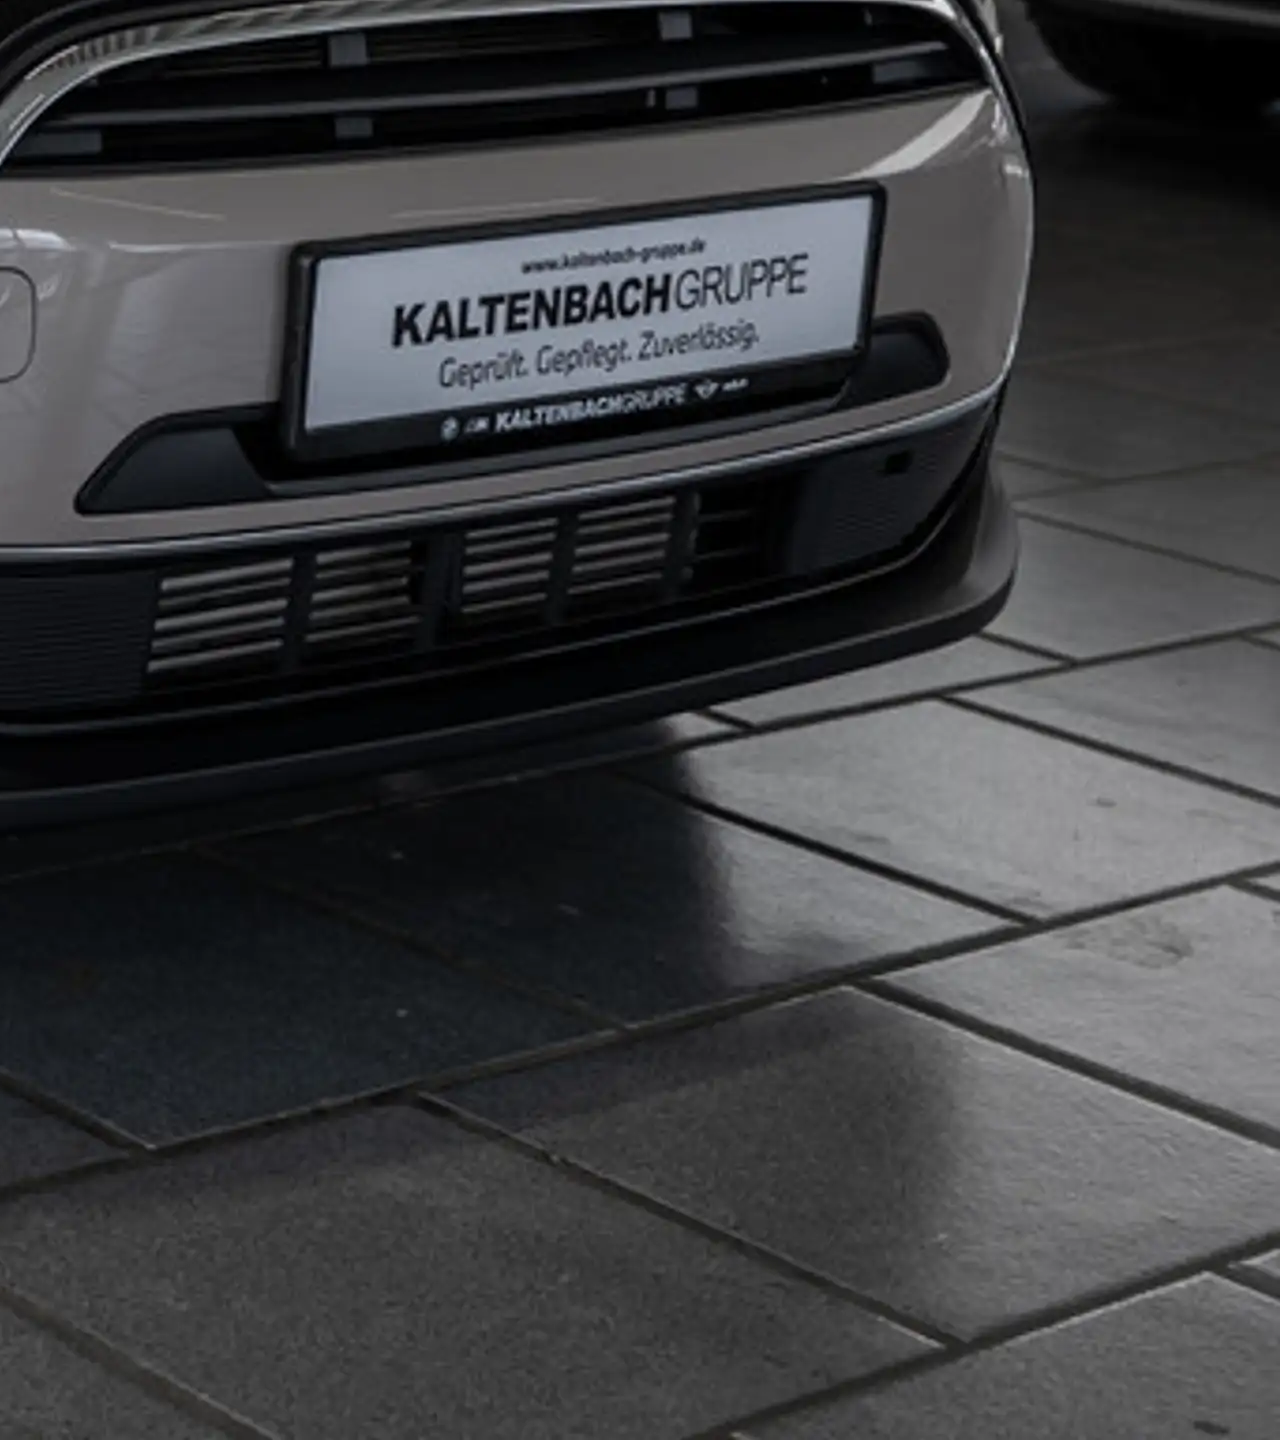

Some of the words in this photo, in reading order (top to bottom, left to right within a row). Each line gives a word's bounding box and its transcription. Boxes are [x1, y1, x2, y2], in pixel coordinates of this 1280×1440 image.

[521, 237, 706, 274] www.kaltenbach-gruppe.de
[391, 253, 809, 348] KALTENBACHGRUPPE
[439, 348, 528, 391] Geprüft.
[536, 338, 631, 377] Gepflegt.
[494, 382, 687, 433] KALTENBACHGRUPPE
